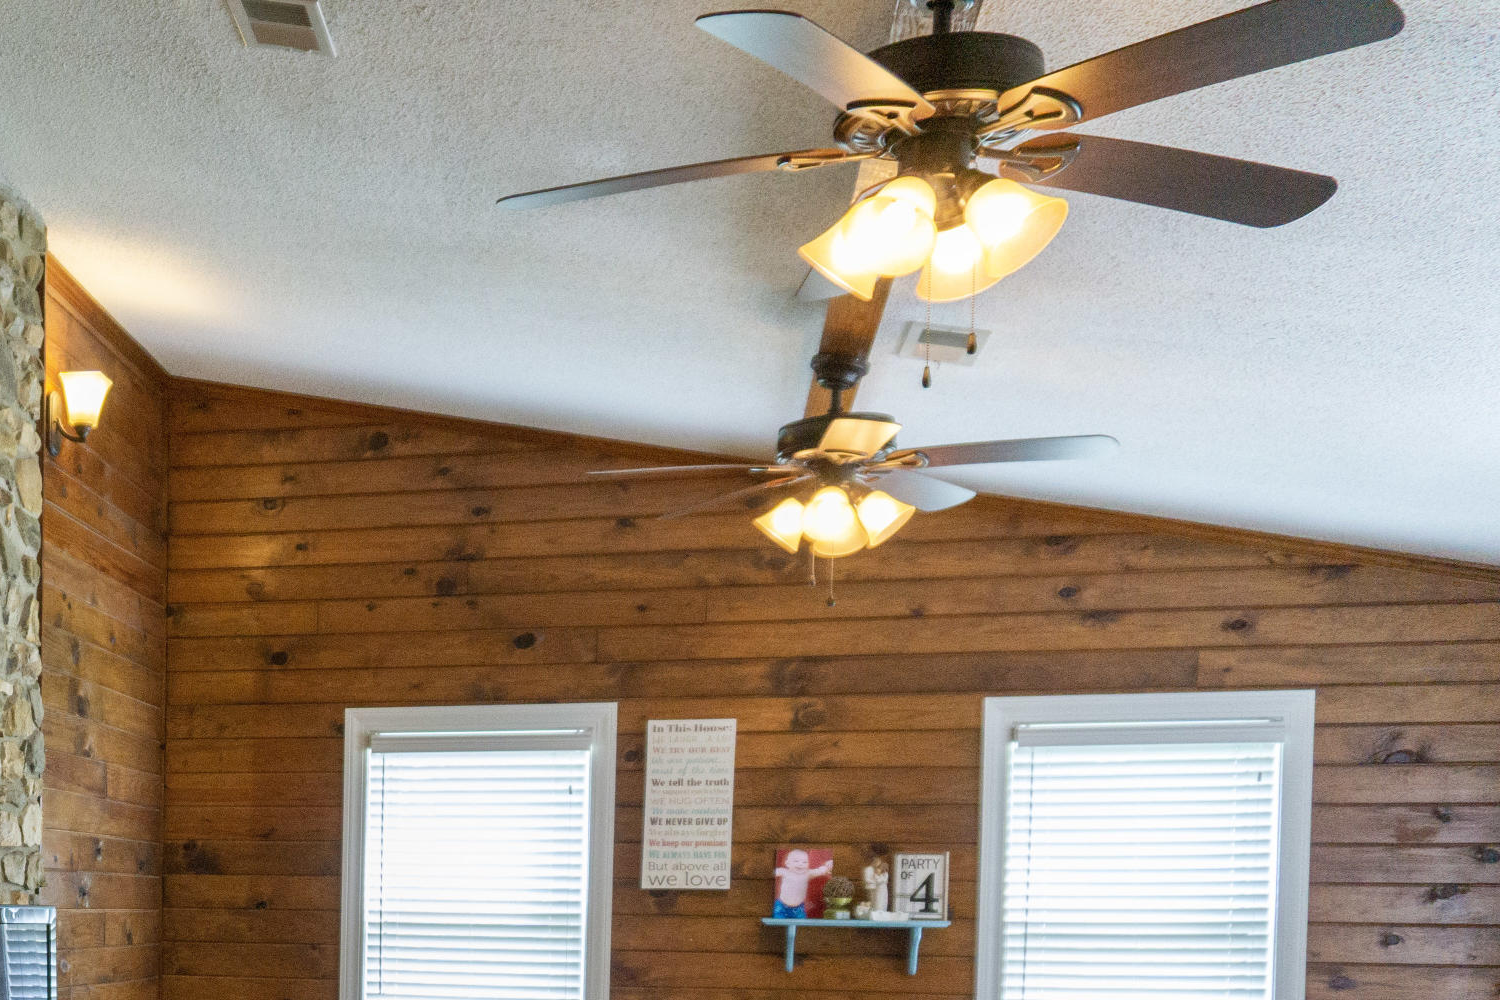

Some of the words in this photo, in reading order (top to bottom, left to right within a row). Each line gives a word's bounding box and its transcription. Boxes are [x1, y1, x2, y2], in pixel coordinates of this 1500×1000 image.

[653, 725, 664, 733] In
[667, 724, 692, 732] This
[651, 778, 665, 787] We
[668, 778, 684, 786] tell
[687, 777, 702, 786] the
[705, 777, 729, 786] truth
[694, 796, 730, 805] OFTEN
[649, 816, 663, 826] WE
[665, 817, 693, 826] NEVER
[695, 817, 715, 825] GIVE
[717, 817, 728, 825] UP
[649, 839, 660, 847] We
[662, 839, 679, 848] keep
[662, 850, 691, 859] ALWAYS
[693, 850, 712, 859] HAVE
[648, 861, 669, 871] But
[672, 861, 709, 871] above
[712, 861, 727, 871] all
[901, 858, 941, 870] PARTY
[648, 874, 678, 886] we
[685, 871, 727, 887] love
[900, 872, 913, 880] OF
[909, 872, 940, 913] 4
